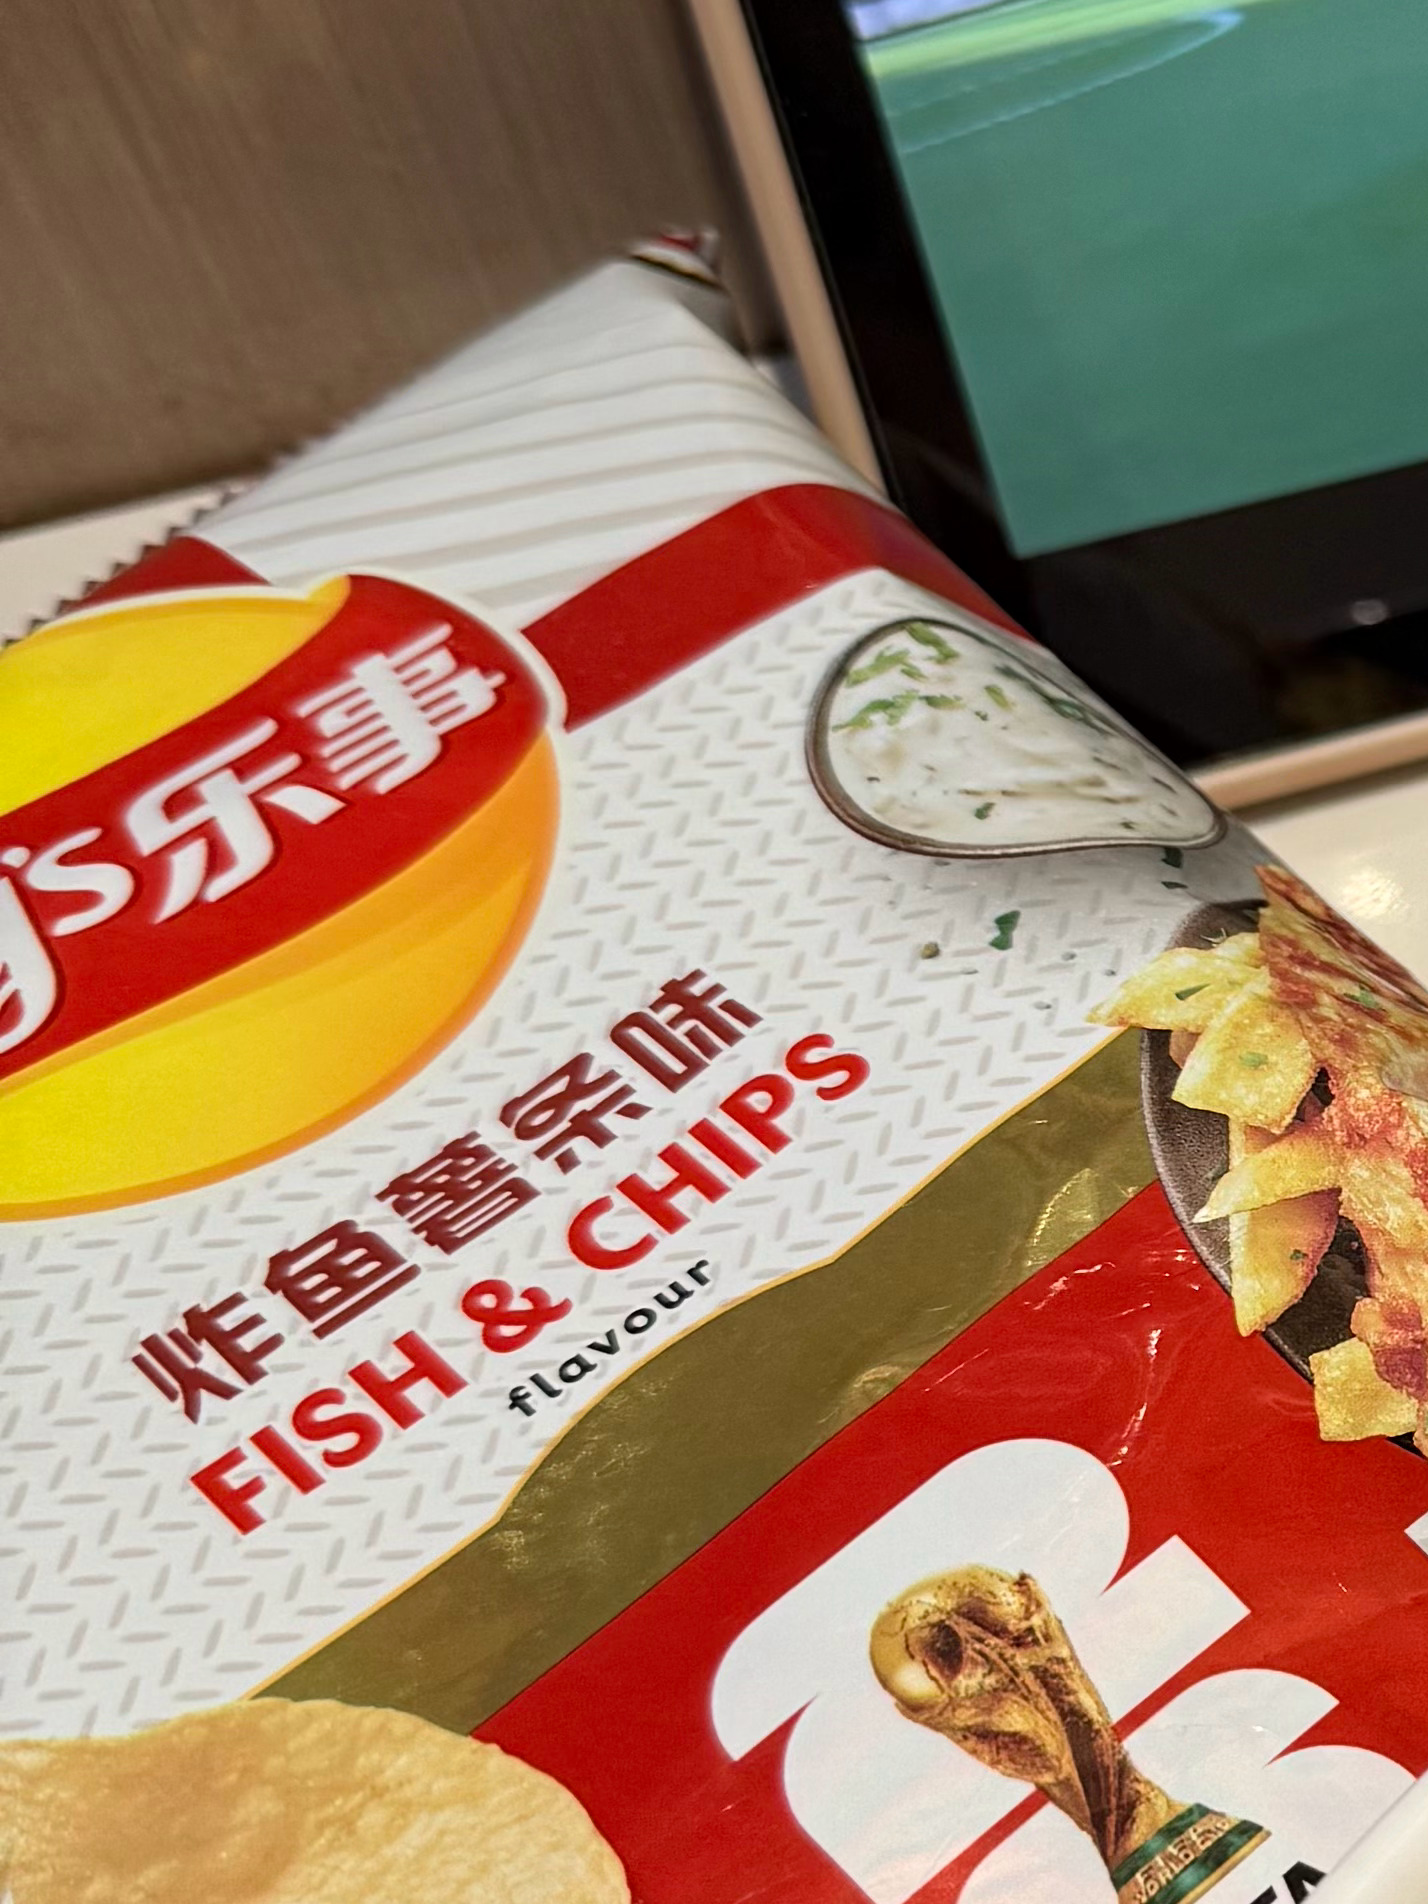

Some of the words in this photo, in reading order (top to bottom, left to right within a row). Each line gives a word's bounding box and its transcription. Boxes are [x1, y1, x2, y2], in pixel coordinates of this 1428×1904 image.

[125, 622, 508, 925] 乐事
[131, 968, 764, 1425] 炸鱼薯条味
[190, 1330, 470, 1536] FISH
[461, 1279, 573, 1355] &
[567, 1032, 872, 1271] CHIPS
[508, 1256, 715, 1418] flavour
